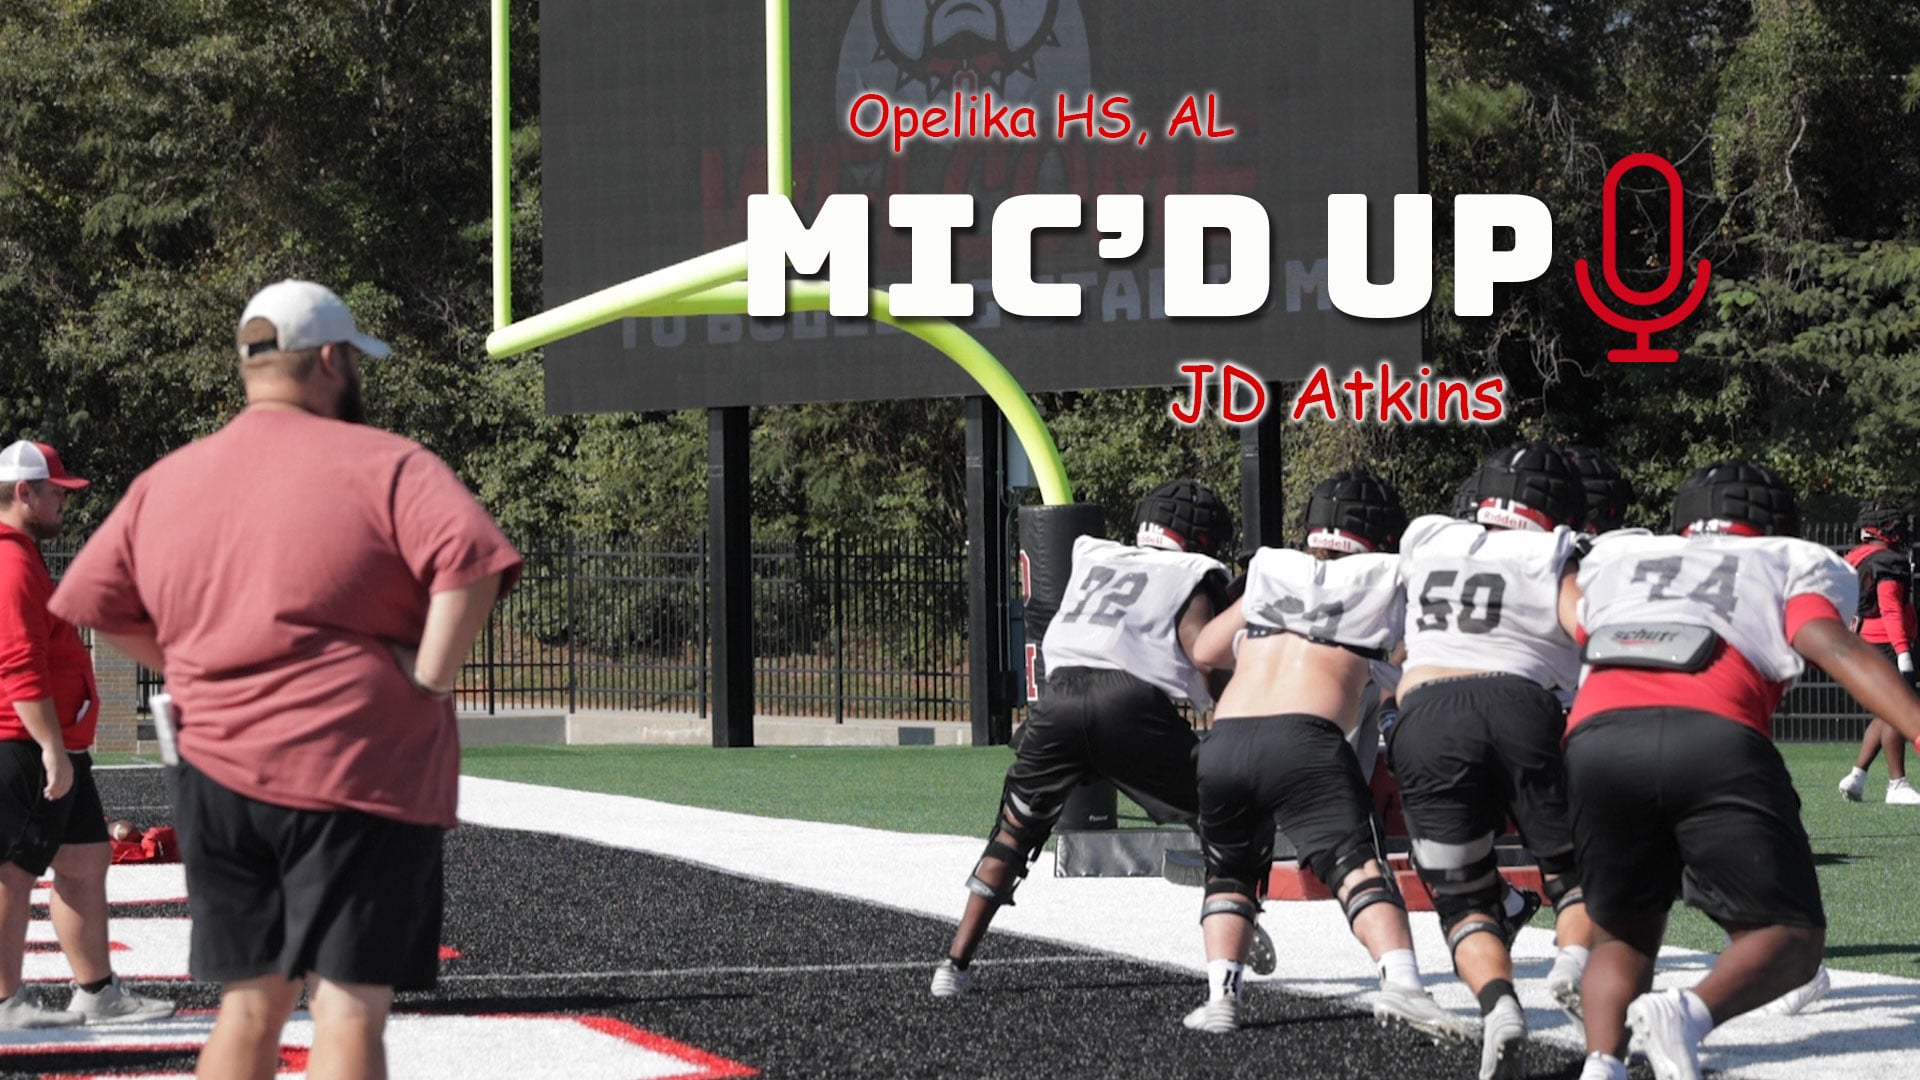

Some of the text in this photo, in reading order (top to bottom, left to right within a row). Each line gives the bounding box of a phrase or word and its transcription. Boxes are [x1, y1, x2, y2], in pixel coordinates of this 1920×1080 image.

[1312, 535, 1353, 550] Riddell
[1484, 511, 1528, 530] Riddell
[1061, 565, 1149, 629] 72
[1416, 570, 1507, 634] 50
[1629, 554, 1740, 624] 74
